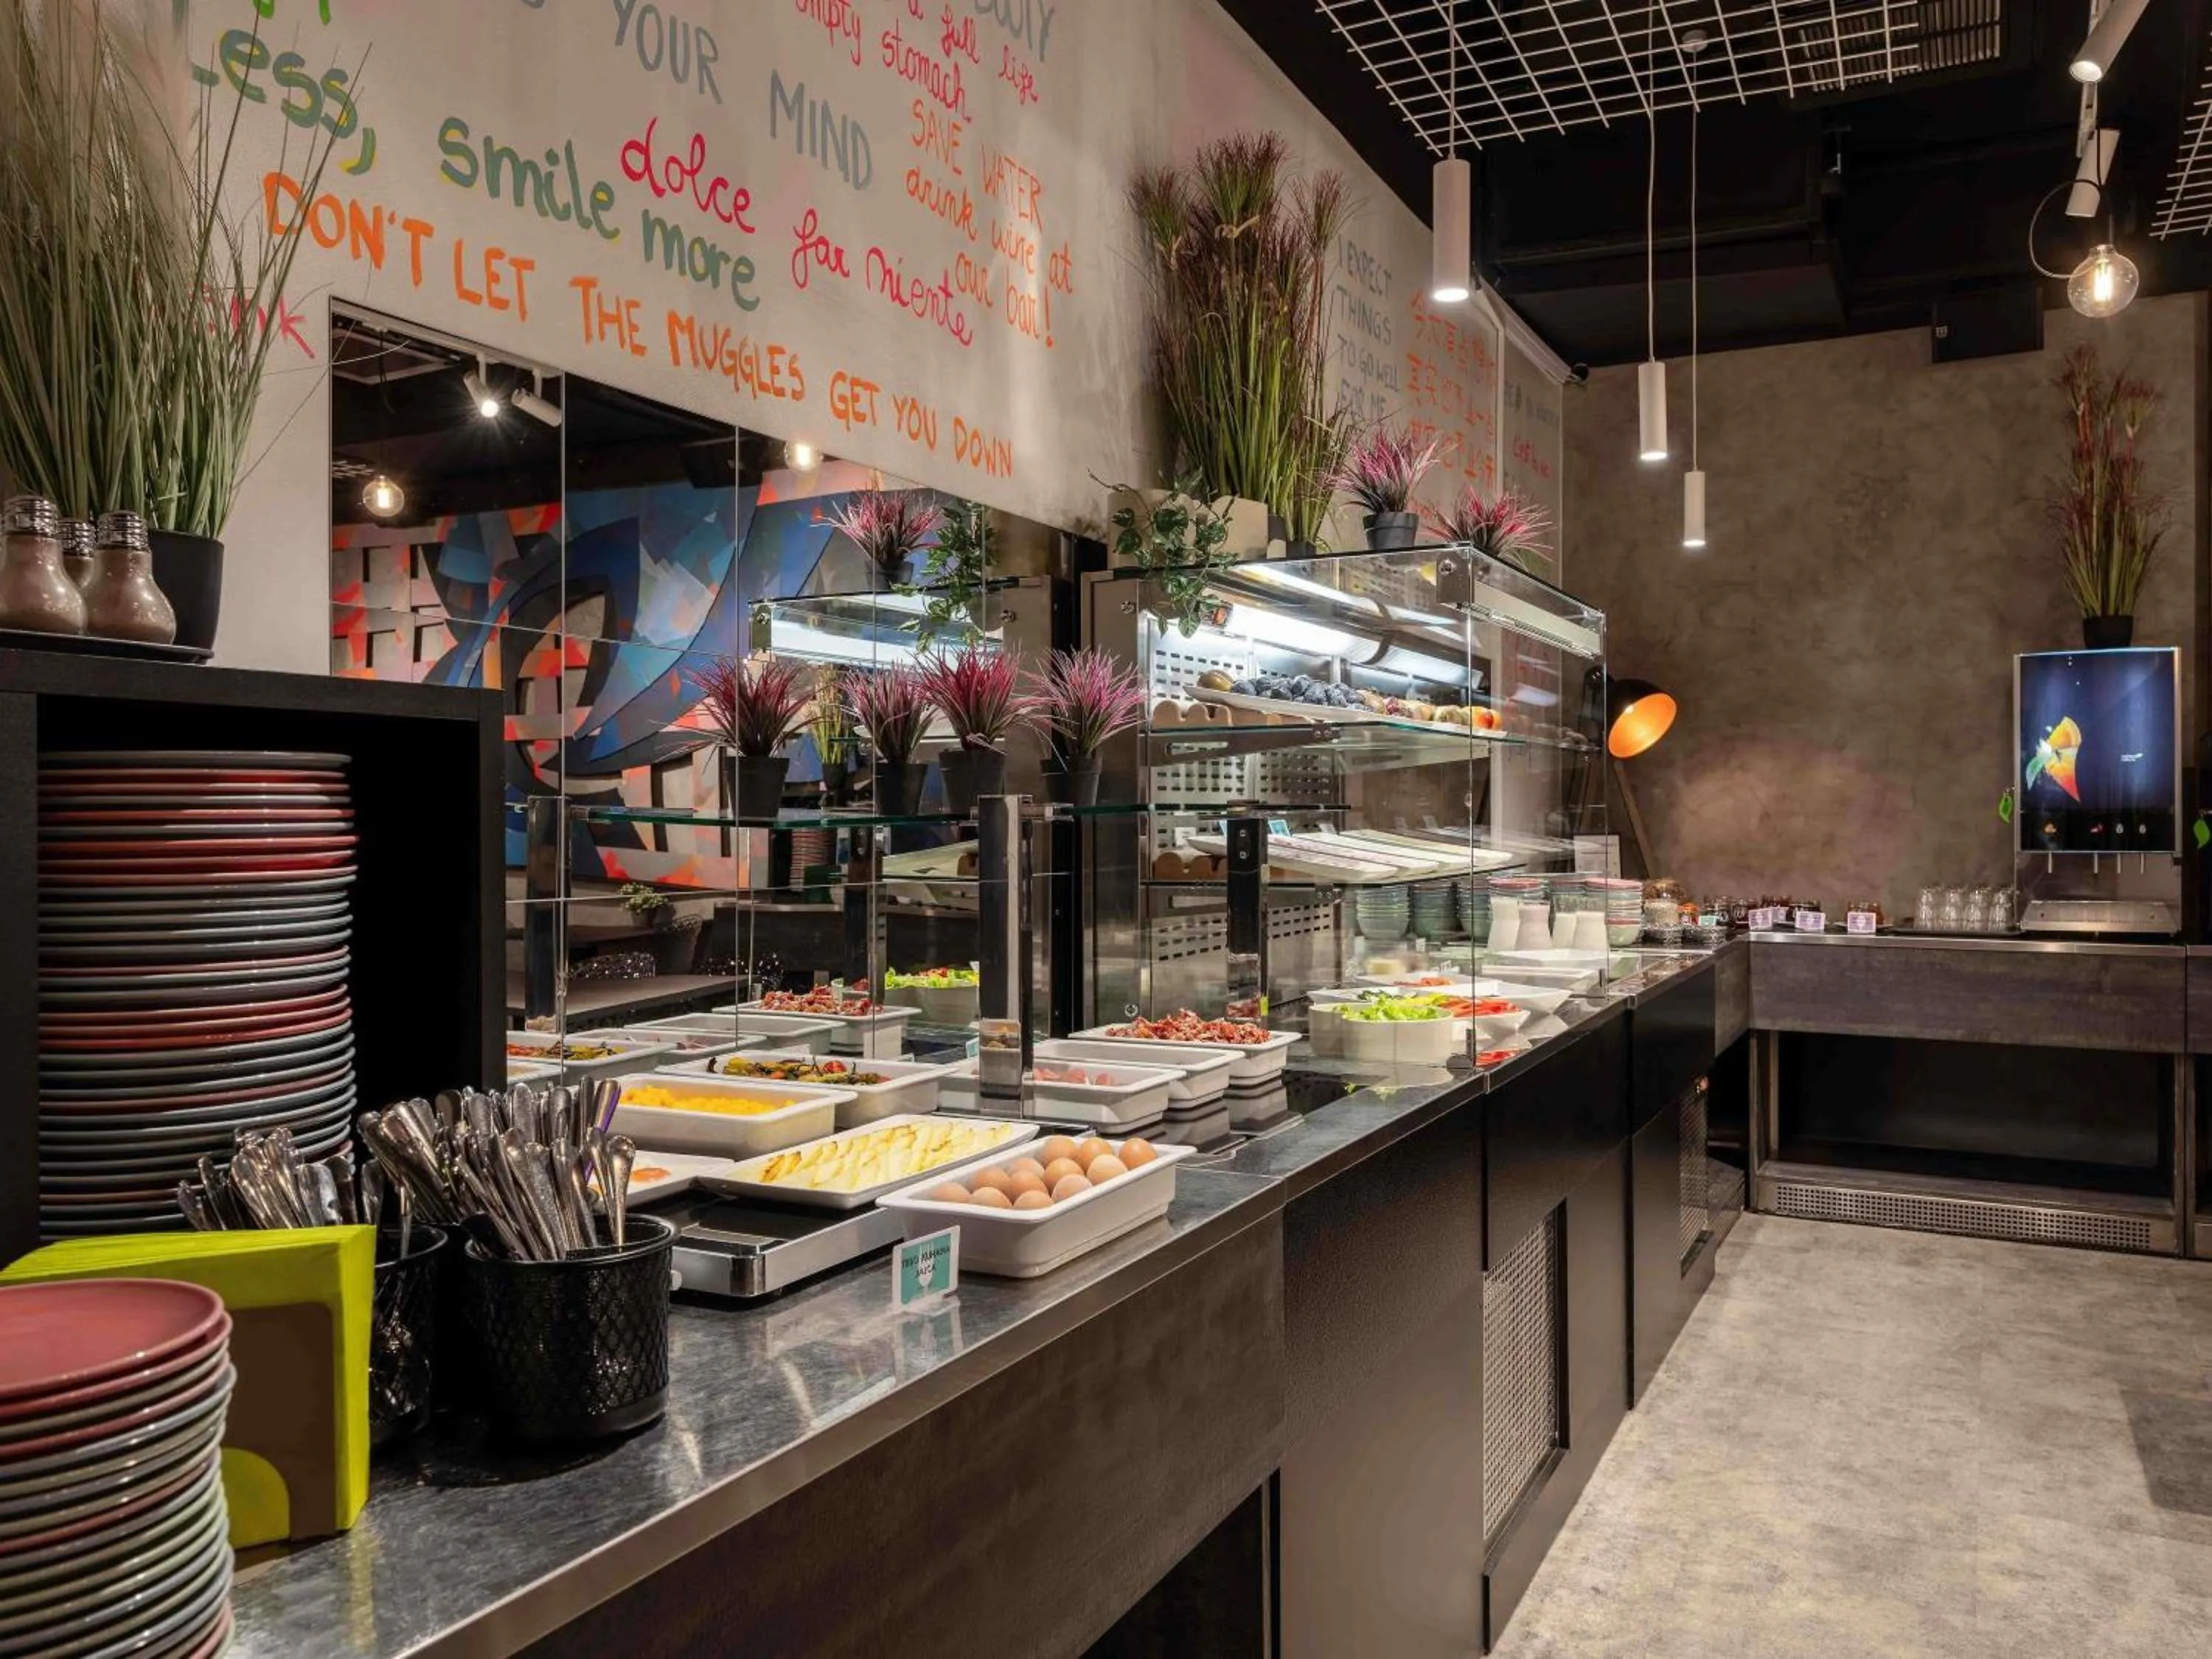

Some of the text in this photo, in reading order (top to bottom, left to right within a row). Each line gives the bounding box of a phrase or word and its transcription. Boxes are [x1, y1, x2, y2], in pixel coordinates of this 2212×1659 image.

[613, 0, 872, 191] YOUR MIND
[941, 4, 980, 64] full
[192, 28, 760, 312] ess, smile more
[620, 116, 755, 234] dolce
[791, 207, 851, 290] far
[906, 164, 1074, 294] drink wine at
[911, 98, 1043, 234] SAVE WATER
[262, 171, 1015, 479] DON'T LET THE MUGGLES GET YOU DOWN
[955, 251, 1054, 349] our bar!
[1337, 284, 1392, 346] THINGS
[1338, 234, 1392, 299] I EXPECT
[1337, 334, 1399, 393] TO GO WELL
